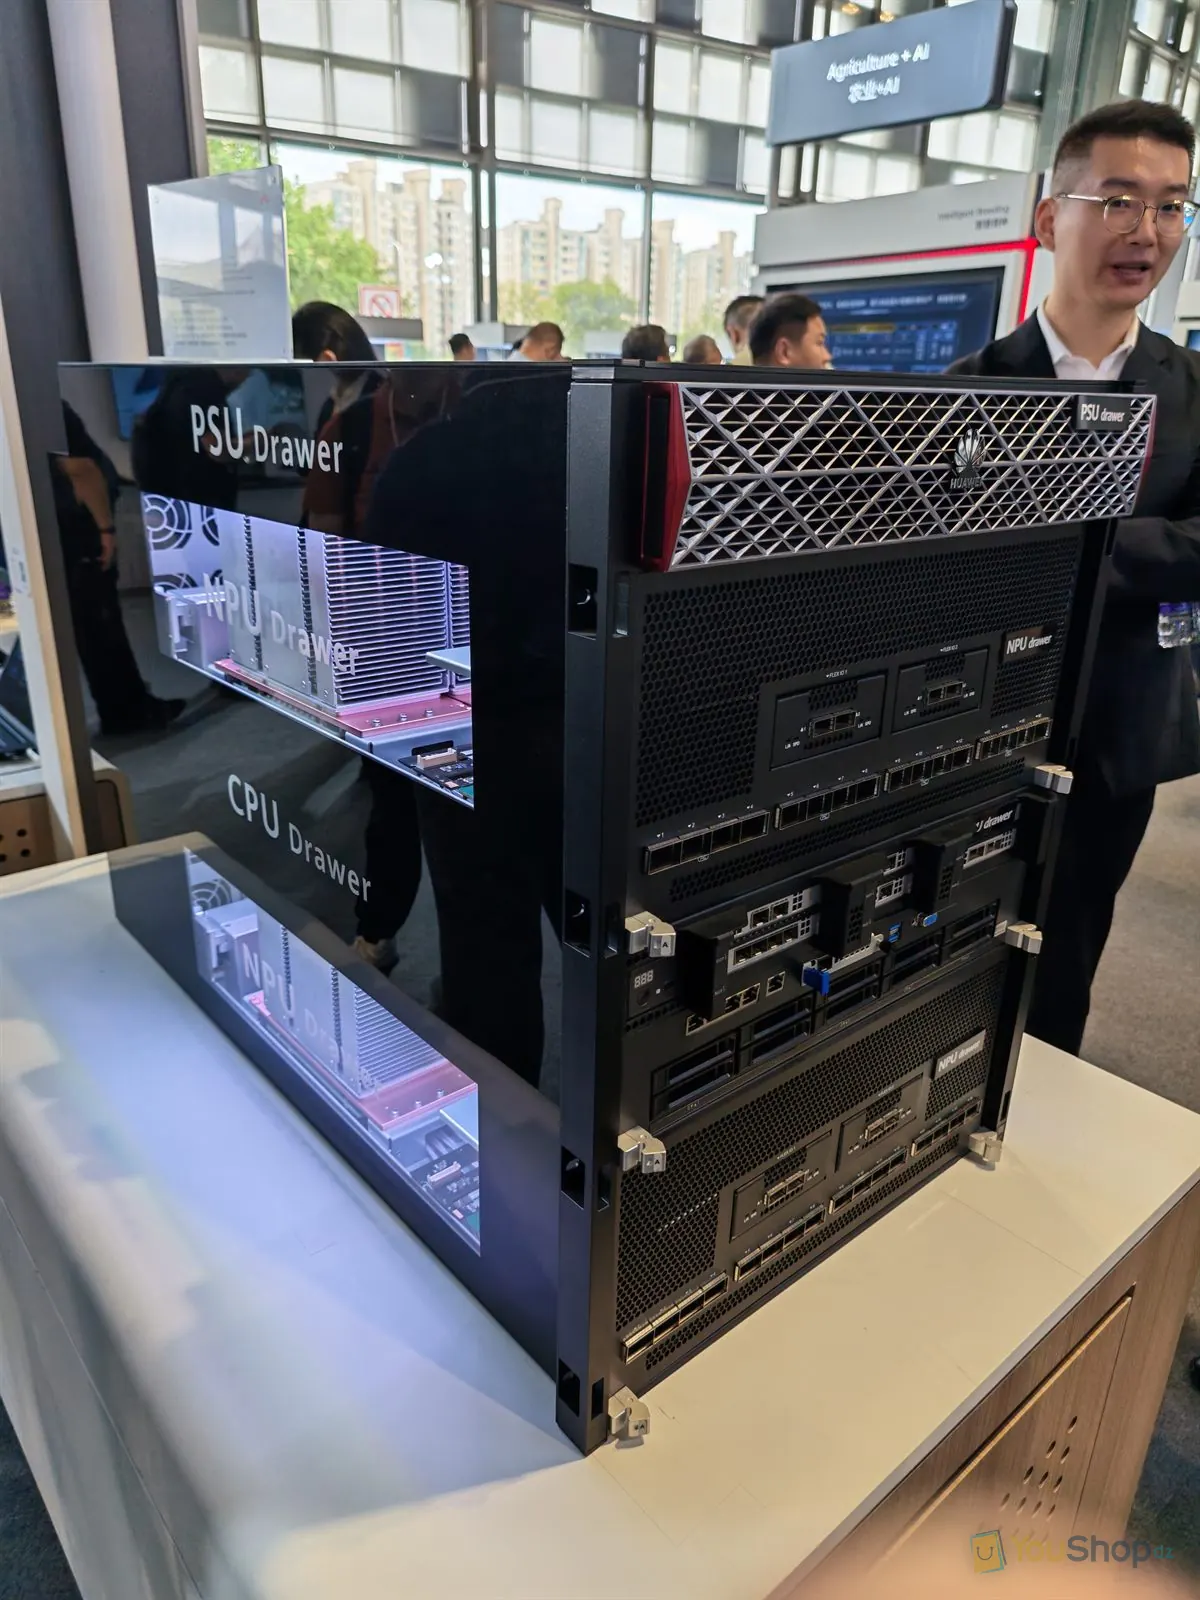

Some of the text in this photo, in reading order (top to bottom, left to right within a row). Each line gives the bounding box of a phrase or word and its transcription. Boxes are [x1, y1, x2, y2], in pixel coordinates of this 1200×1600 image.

[826, 51, 900, 83] Agriculture
[912, 41, 930, 62] AI
[1080, 403, 1125, 422] PSU drawer
[253, 424, 344, 474] Drawer
[203, 572, 360, 677] NPU Drawer
[1006, 635, 1053, 655] NPU drawer
[227, 774, 372, 903] CPU Drawer
[983, 810, 1014, 829] drawer
[242, 942, 297, 1018] NPU
[938, 1051, 958, 1072] NPU
